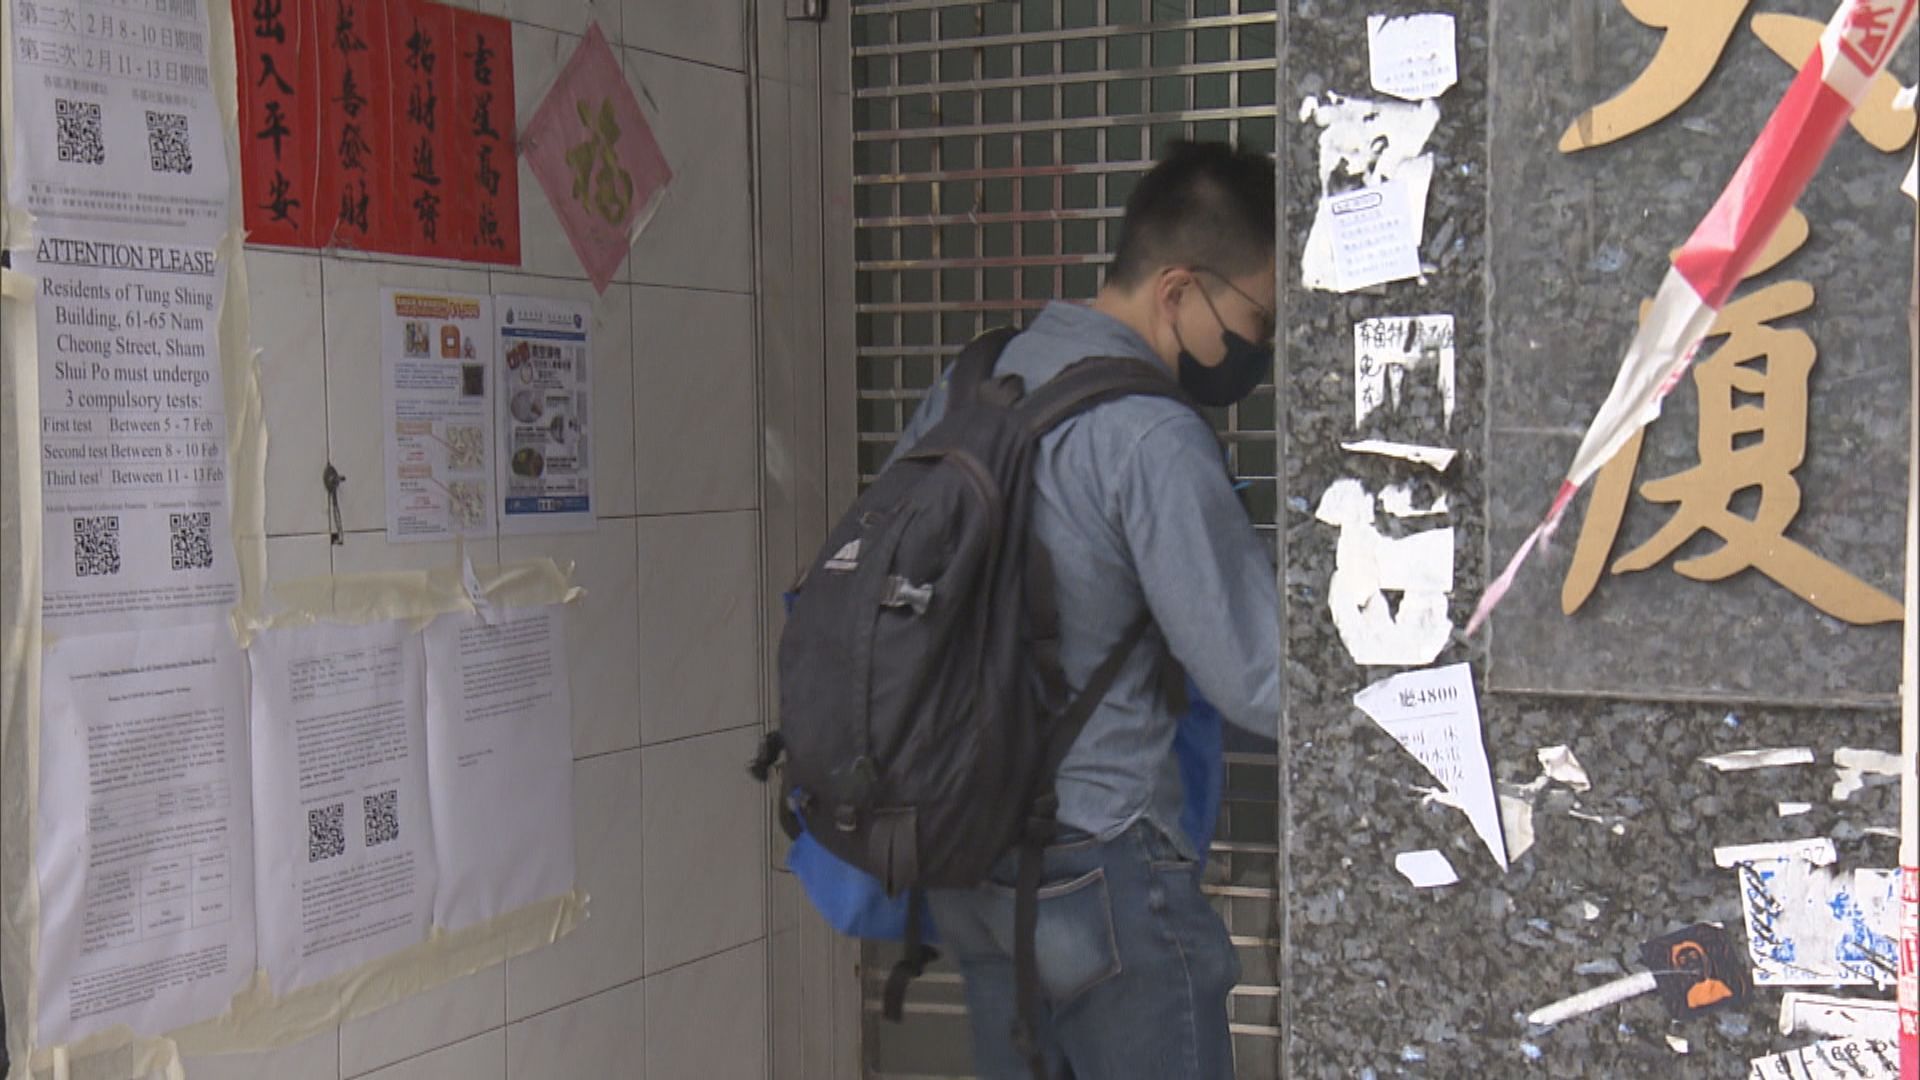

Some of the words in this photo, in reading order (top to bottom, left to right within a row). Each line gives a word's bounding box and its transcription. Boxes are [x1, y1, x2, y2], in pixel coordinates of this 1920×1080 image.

[20, 2, 76, 33] 第二次
[254, 0, 300, 231] 出入平安
[564, 97, 633, 225] 福
[36, 238, 144, 268] ATTENTION
[149, 247, 215, 273] PLEASE
[43, 277, 111, 300] Residents
[115, 283, 133, 301] of
[134, 285, 170, 308] Tung
[175, 287, 213, 310] Shing
[56, 306, 121, 331] Building,
[126, 310, 166, 330] 61-65
[170, 313, 204, 332] Nam
[57, 334, 111, 358] Cheong
[116, 336, 161, 358] Street,
[166, 338, 205, 357] Sham
[55, 362, 87, 380] Shui
[92, 363, 110, 380] Po
[114, 367, 148, 381] must
[153, 365, 209, 387] undergo
[66, 389, 73, 407] 3
[78, 390, 161, 412] compulsory
[167, 392, 201, 408] tests:
[43, 417, 70, 432] First
[73, 419, 92, 432] test
[110, 418, 161, 432] Between
[164, 418, 171, 432] 5
[184, 418, 190, 431] 7
[194, 417, 213, 432] Feb
[44, 444, 86, 459] Second
[88, 445, 107, 459] test
[111, 444, 162, 458] Between
[165, 444, 172, 457] 8
[186, 443, 198, 456] 10
[202, 443, 219, 457] Feb
[45, 470, 76, 485] Third
[112, 469, 163, 484] Between
[167, 469, 180, 483] 11
[194, 468, 203, 482] 13
[206, 467, 224, 481] Feb
